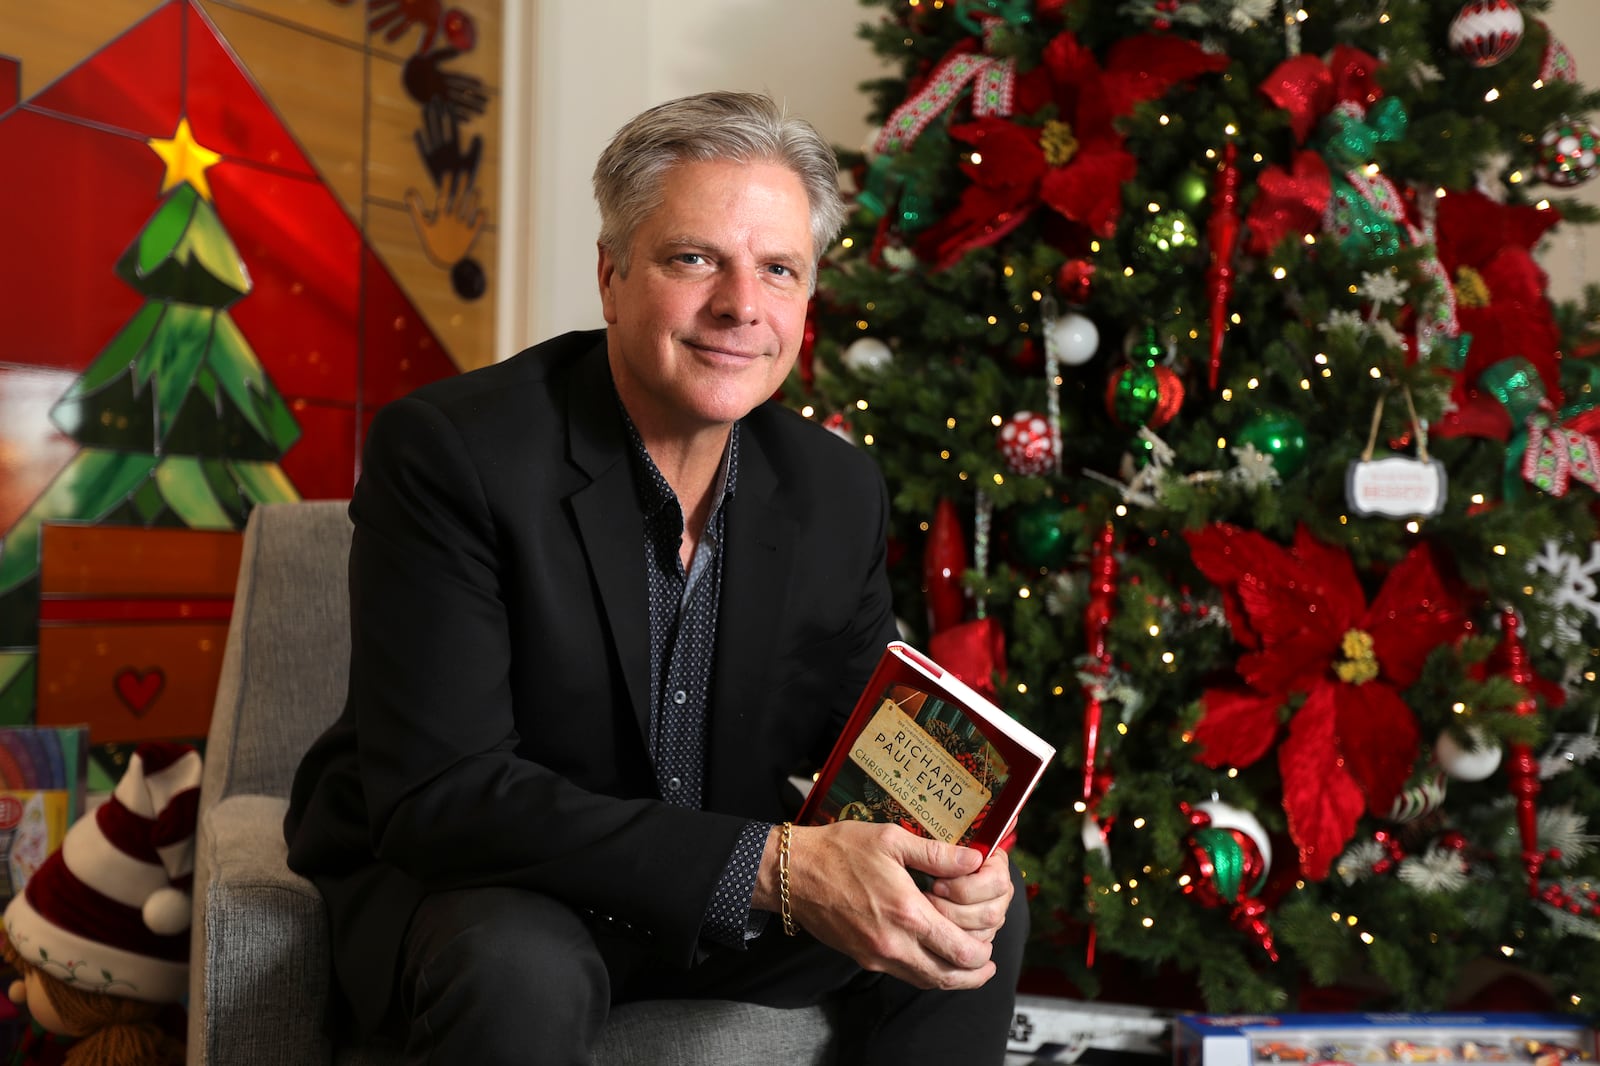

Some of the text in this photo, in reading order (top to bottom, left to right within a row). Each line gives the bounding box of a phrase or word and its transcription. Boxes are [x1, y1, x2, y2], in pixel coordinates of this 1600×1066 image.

[856, 749, 909, 800] CHRISTMAS
[909, 799, 954, 843] PROMISE
[875, 733, 910, 771] PAUL
[916, 771, 965, 820] EVANS
[894, 731, 962, 796] RICHARD
[904, 778, 918, 793] THE
